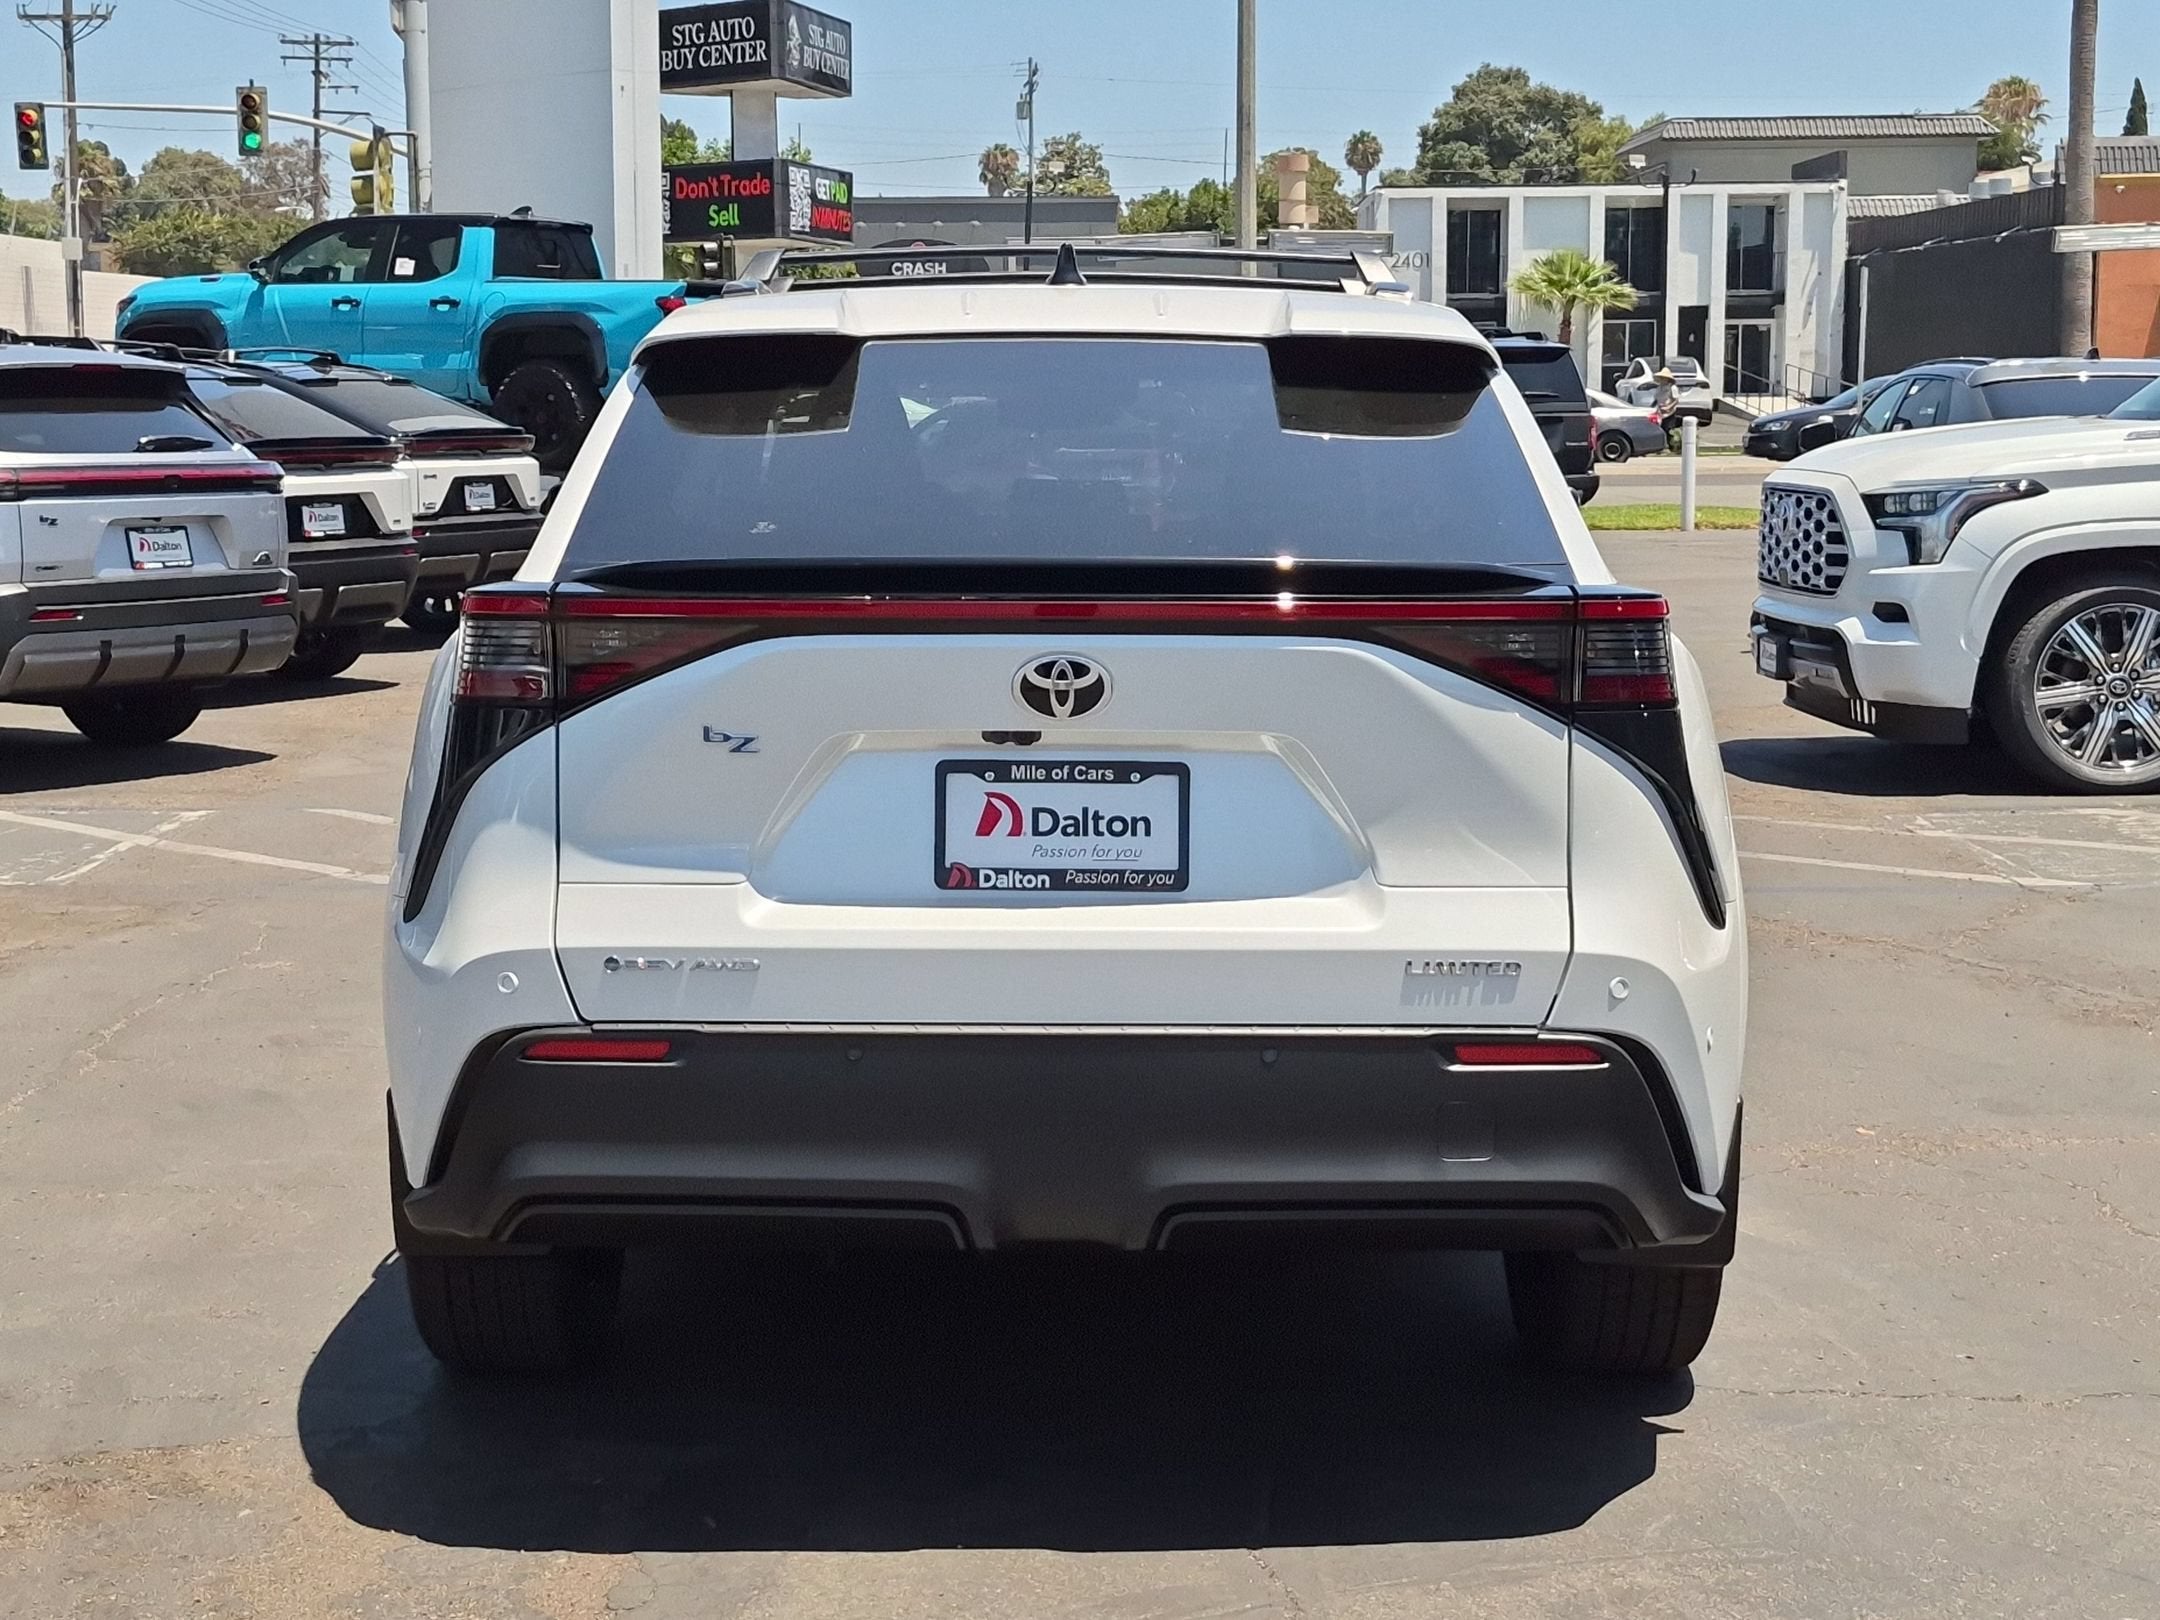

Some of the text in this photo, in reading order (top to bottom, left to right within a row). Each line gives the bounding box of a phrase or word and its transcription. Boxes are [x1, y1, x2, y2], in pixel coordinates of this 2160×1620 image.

[672, 16, 755, 46] STG AUTO
[808, 23, 846, 55] STG AUTO
[661, 39, 768, 71] BUY CENTER
[803, 45, 850, 80] BUY CENTER
[675, 171, 771, 199] Don't Trade
[815, 177, 830, 200] GET
[708, 203, 740, 227] Sell
[891, 262, 947, 275] CRASH
[1391, 252, 1430, 268] 2401
[152, 541, 182, 552] Dalton
[1011, 765, 1115, 781] Mile of Cars
[1031, 806, 1152, 837] Dalton
[1032, 844, 1143, 860] Passion for you
[979, 869, 1051, 889] Dalton
[1065, 869, 1175, 886] Passion for you
